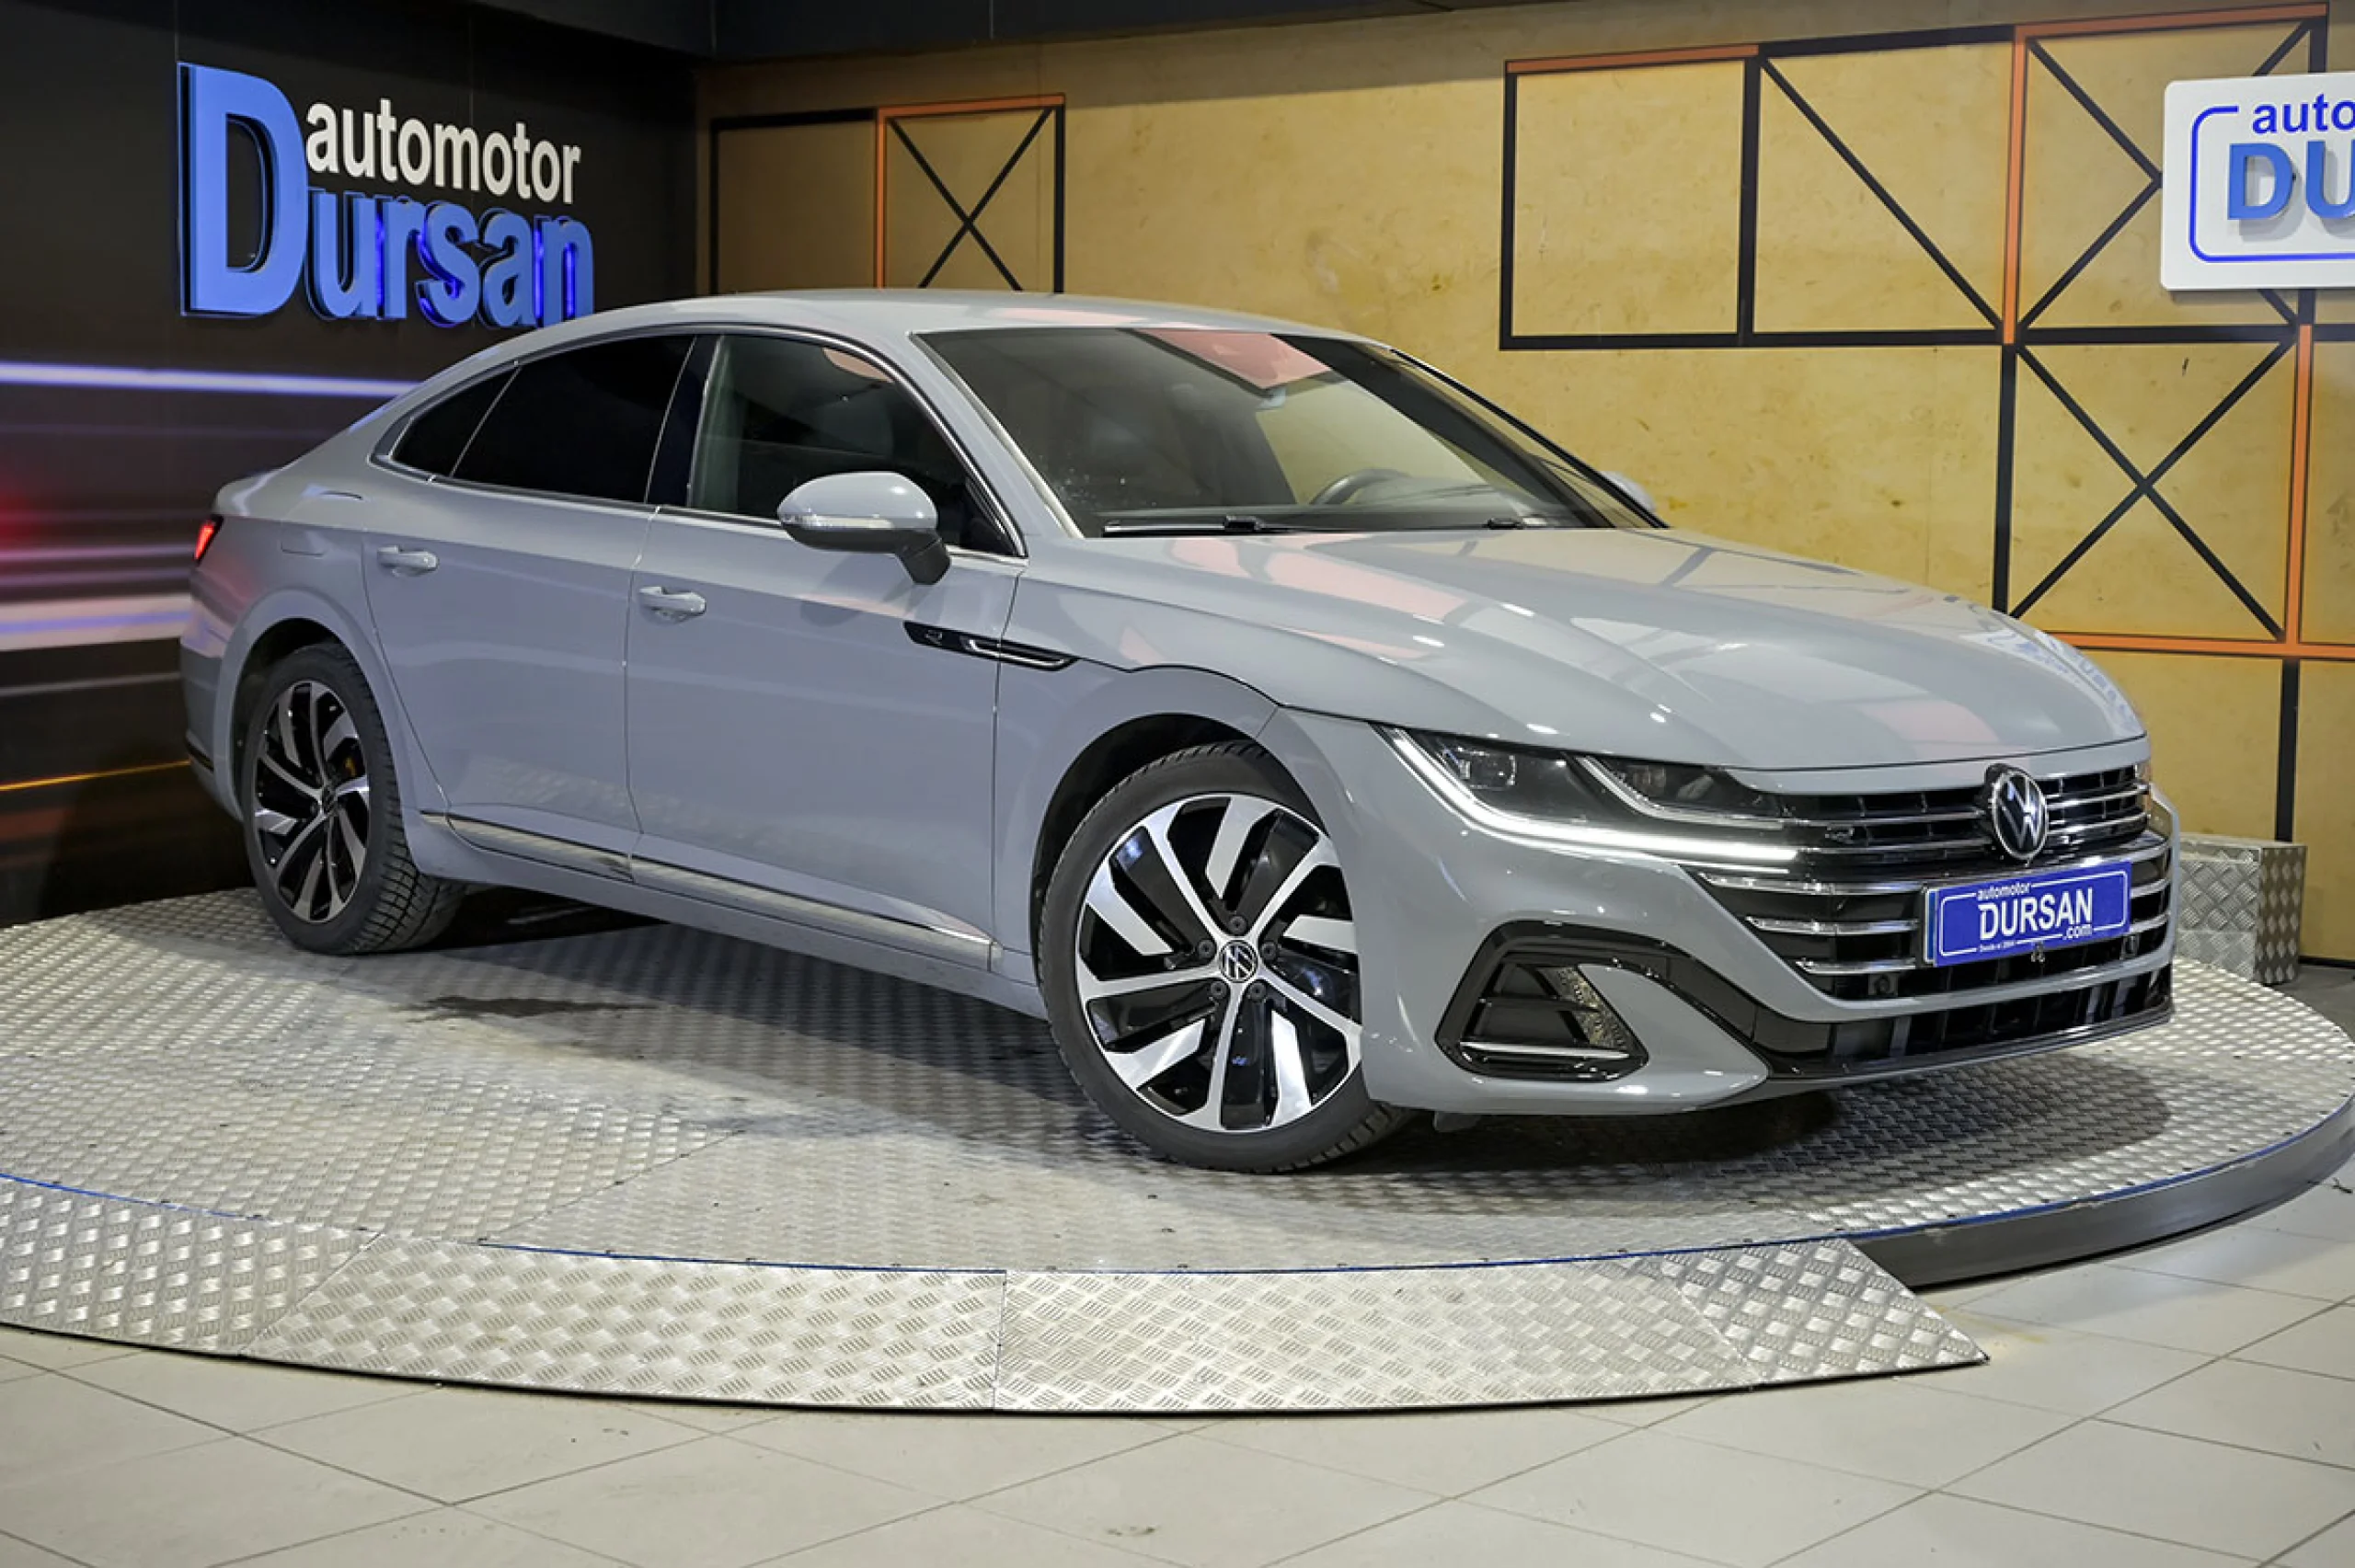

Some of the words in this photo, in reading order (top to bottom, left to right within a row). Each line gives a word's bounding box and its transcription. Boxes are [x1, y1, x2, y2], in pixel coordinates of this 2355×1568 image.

[2252, 93, 2355, 134] auto
[305, 97, 581, 205] automotor
[177, 61, 594, 329] Dursan
[2227, 140, 2355, 221] DU
[1977, 882, 2031, 902] automotor
[1978, 887, 2093, 941] DURSAN
[2062, 923, 2093, 941] .com
